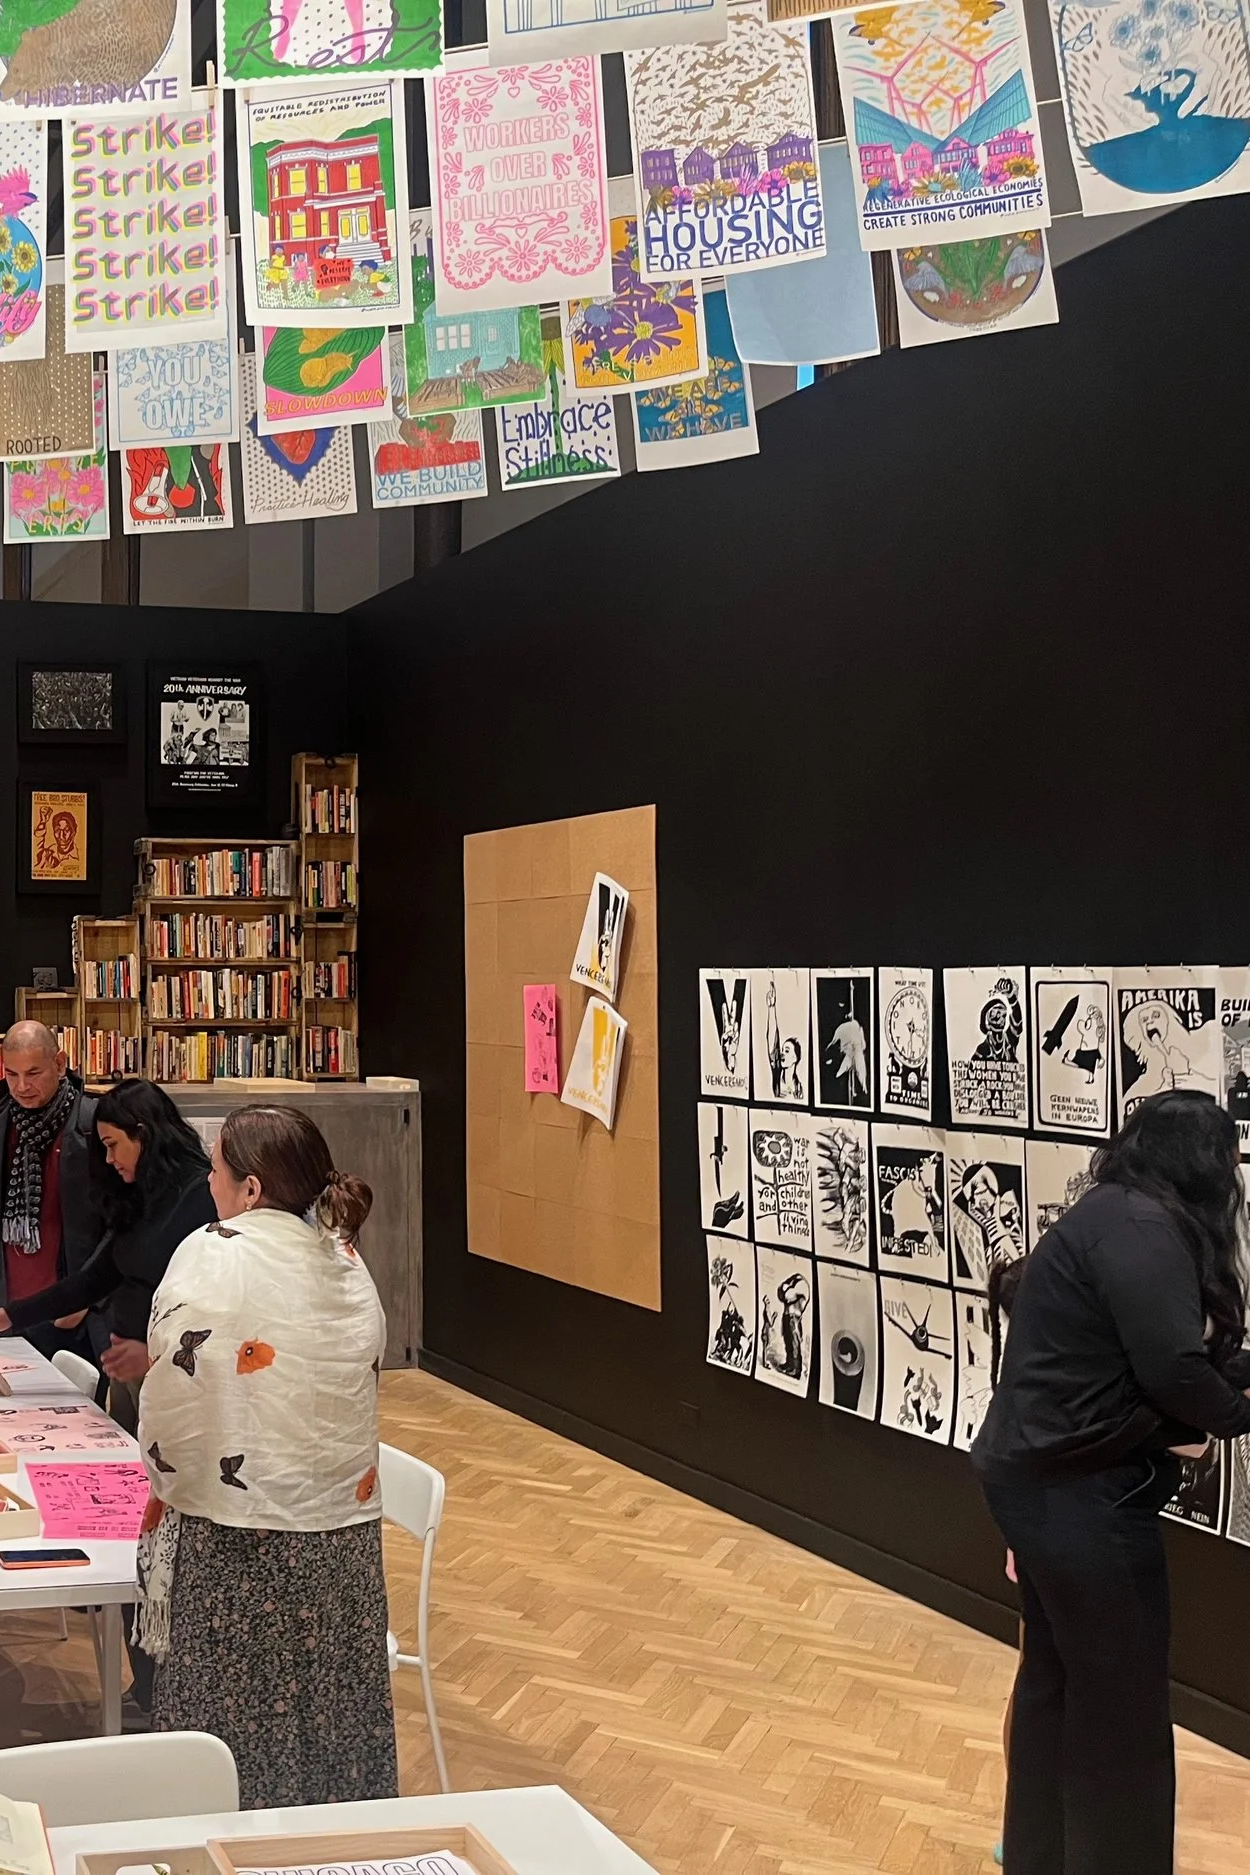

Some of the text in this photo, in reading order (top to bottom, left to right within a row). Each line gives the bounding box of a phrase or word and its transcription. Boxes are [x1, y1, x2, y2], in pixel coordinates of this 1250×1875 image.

[23, 77, 178, 108] HIBERNATE
[253, 90, 386, 116] EQUITABLE REDISTRIBUTION
[270, 107, 324, 121] RESOURCES
[330, 104, 350, 112] AND
[355, 98, 385, 108] POWER
[71, 112, 217, 159] Strike!
[463, 111, 570, 153] WORKERS
[71, 151, 218, 200] Strike!
[490, 151, 547, 183] OVER
[448, 178, 594, 224] BILLIONAIRES
[645, 179, 819, 226] AFFORDABLE
[934, 188, 990, 204] ECOLOGICAL
[993, 177, 1044, 196] ECONOMIES
[71, 193, 218, 241] Strike!
[863, 193, 1044, 231] CREATE STRONG COMMUNITIES
[646, 199, 824, 255] HOUSING
[72, 235, 218, 283] Strike!
[646, 227, 825, 273] FOR EVERYONE
[72, 276, 219, 326] Strike!
[149, 355, 202, 388] YOU
[143, 396, 208, 431] OWE
[265, 387, 388, 416] SLOWDOWN
[501, 401, 612, 443] Embrace
[6, 436, 62, 455] ROOTED
[505, 438, 608, 479] Stillness
[377, 462, 482, 486] WE BUILD
[377, 475, 485, 500] COMMUNITY
[180, 517, 205, 525] WITHIN
[185, 684, 248, 696] ANNIVERSARY
[1121, 989, 1200, 1012] AMERIKA
[1189, 1011, 1203, 1028] IS
[1221, 1013, 1241, 1027] OF
[969, 1070, 1012, 1081] WOMEN YOU
[971, 1061, 986, 1070] YOU
[994, 1091, 1000, 1100] A
[1050, 1094, 1071, 1105] GEEN
[1051, 1112, 1098, 1124] IN EUROPA
[793, 1137, 810, 1148] war
[797, 1146, 805, 1157] is
[794, 1158, 809, 1168] not
[778, 1169, 810, 1187] healthy
[759, 1200, 808, 1212] and other
[782, 1222, 810, 1237] things
[783, 1212, 808, 1226] living
[1191, 1510, 1210, 1525] NEIN
